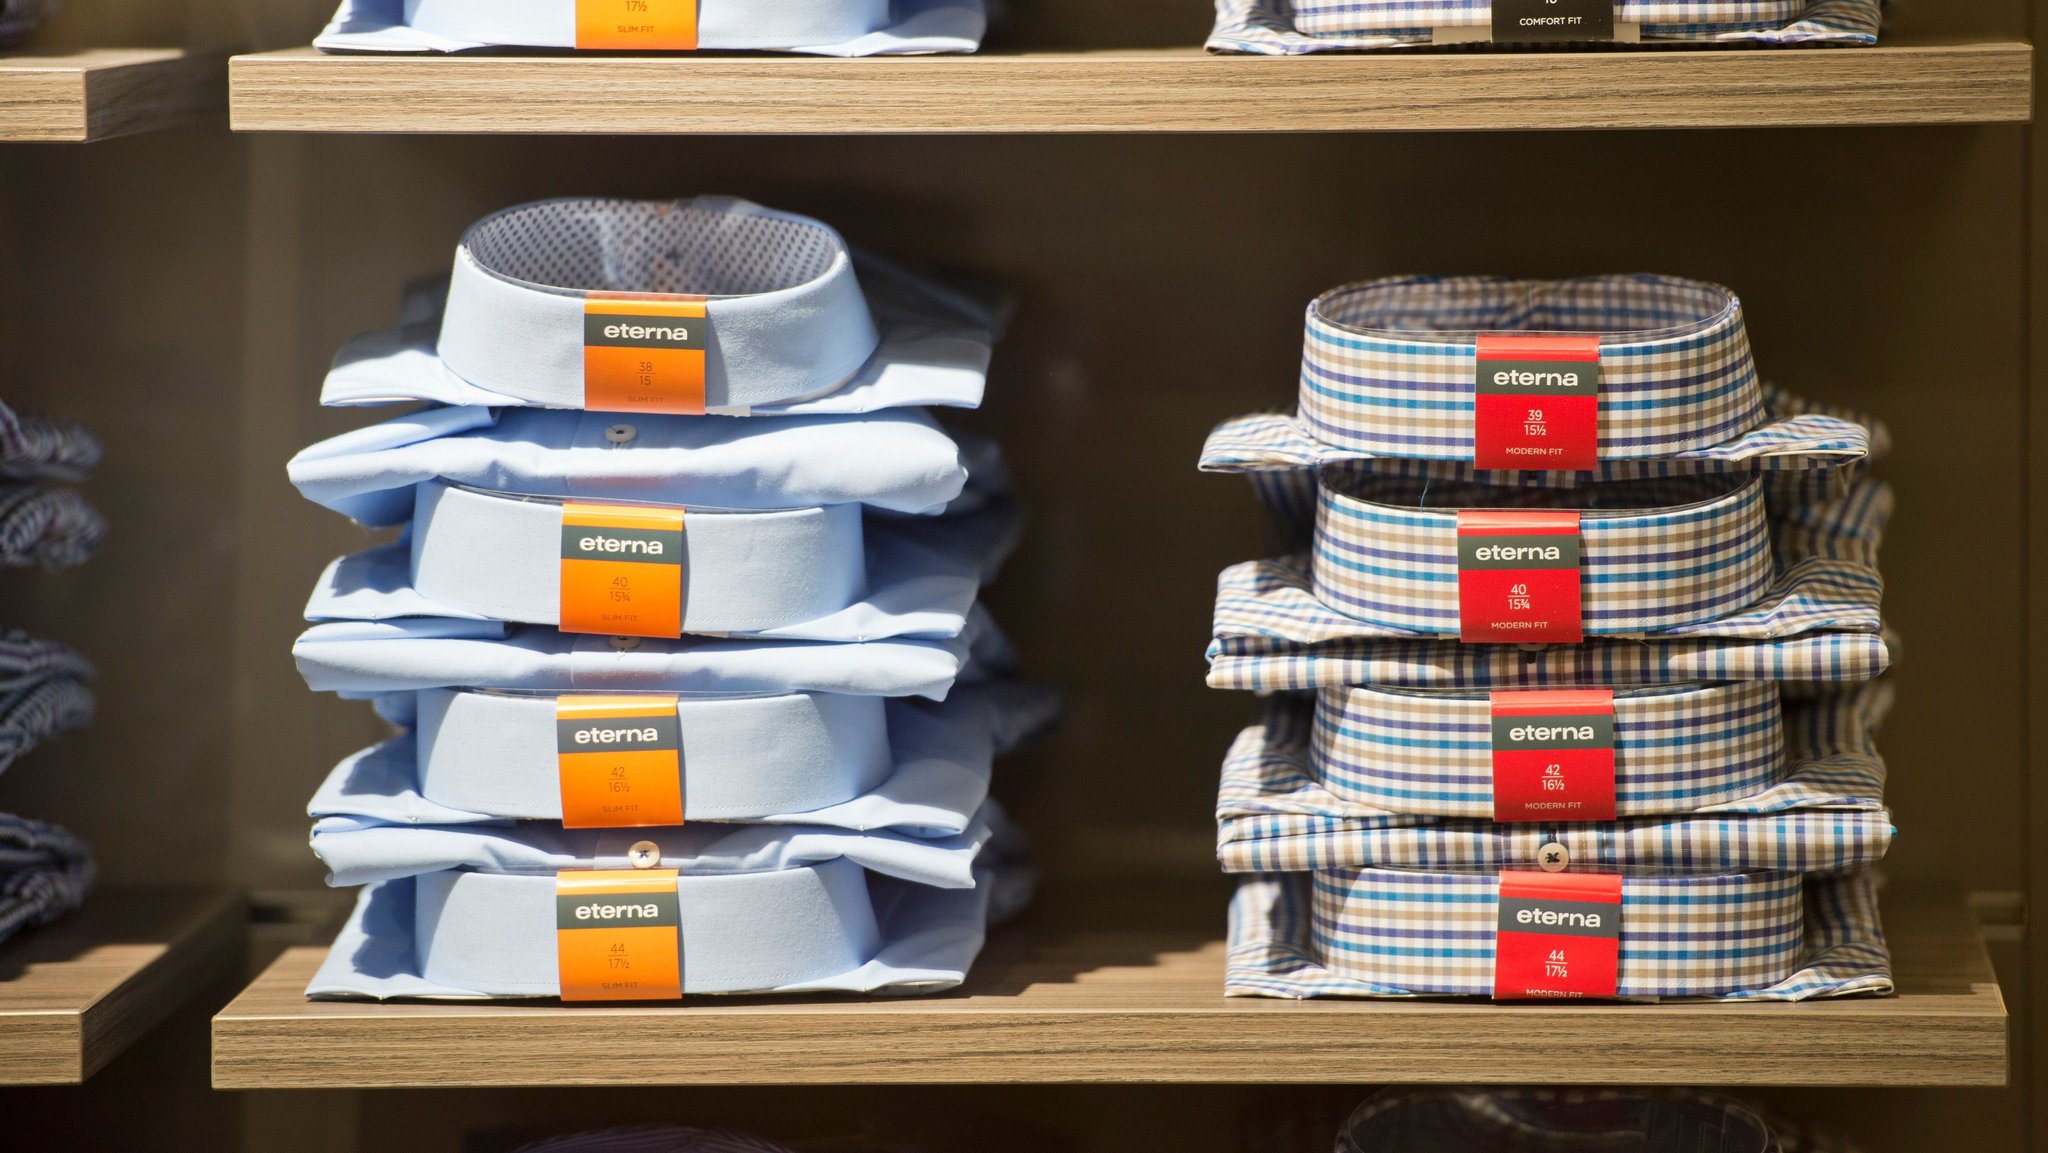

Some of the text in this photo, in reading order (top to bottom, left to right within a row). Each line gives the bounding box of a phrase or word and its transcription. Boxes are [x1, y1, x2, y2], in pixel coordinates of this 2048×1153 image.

[1519, 16, 1582, 26] COMFORT FIT
[617, 25, 654, 33] SLIM FIT
[603, 323, 688, 341] eterna
[639, 361, 653, 372] 38
[639, 375, 651, 386] 15
[1493, 369, 1578, 387] eterna
[627, 395, 664, 404] SLIM FIT
[1527, 409, 1543, 421] 39
[1524, 424, 1547, 436] 15½
[1505, 447, 1563, 456] MODERN FIT
[579, 535, 663, 555] eterna
[1475, 544, 1560, 561] eterna
[612, 576, 628, 588] 40
[1510, 583, 1527, 595] 40
[609, 591, 631, 602] 15¾
[1508, 598, 1530, 610] 15¾
[601, 613, 639, 622] SLIM FIT
[1491, 621, 1548, 629] MODERN FIT
[574, 727, 658, 744] eterna
[1509, 724, 1594, 742] eterna
[611, 766, 625, 778] 42
[1545, 764, 1560, 776] 42
[608, 782, 630, 793] 16½
[1542, 779, 1565, 791] 16½
[602, 804, 639, 813] SLIM FIT
[1524, 801, 1582, 810] MODERN FIT
[575, 903, 659, 920] eterna
[1516, 907, 1601, 928] eterna
[610, 943, 625, 954] 44
[1549, 949, 1565, 962] 44
[608, 958, 630, 969] 17½
[1545, 964, 1568, 978] 17½
[601, 981, 639, 990] SLIM FIT
[1525, 988, 1584, 998] MODERN FIT
